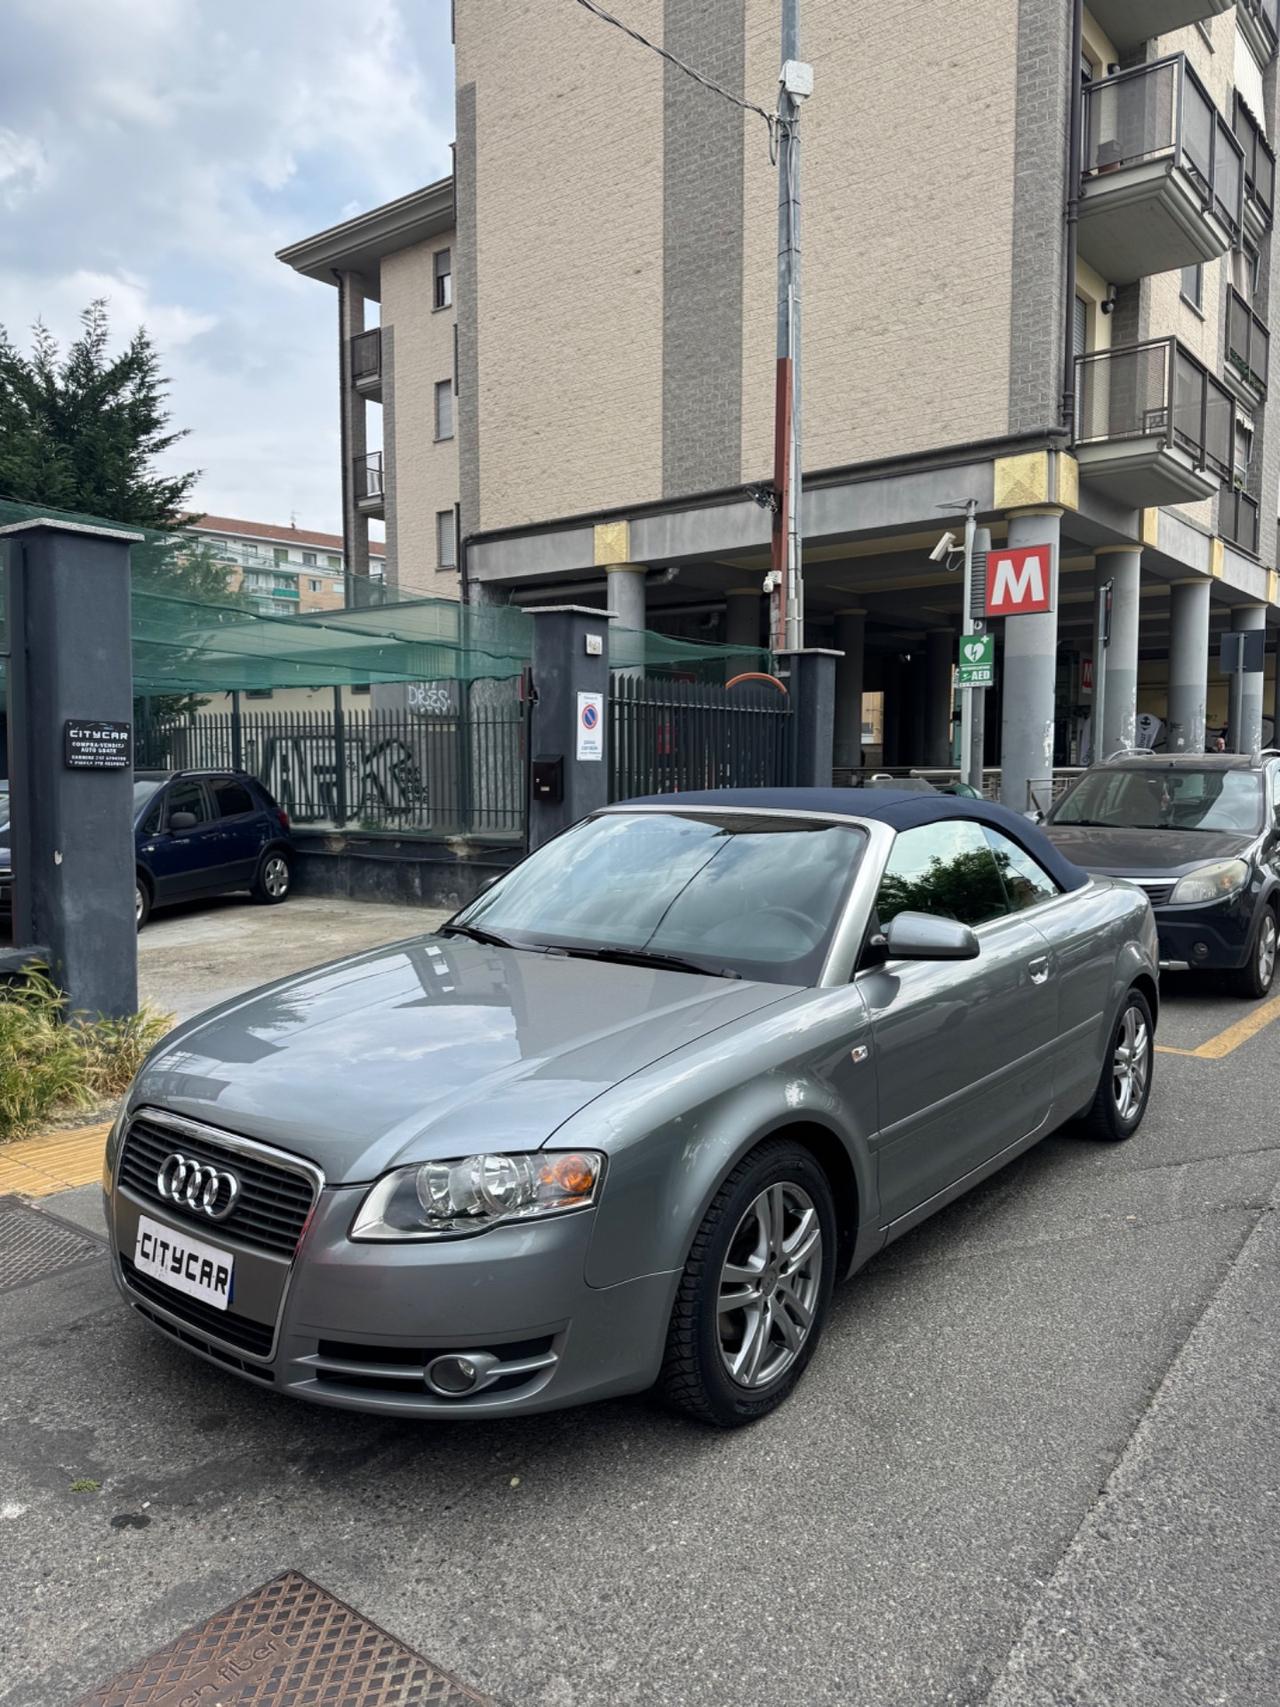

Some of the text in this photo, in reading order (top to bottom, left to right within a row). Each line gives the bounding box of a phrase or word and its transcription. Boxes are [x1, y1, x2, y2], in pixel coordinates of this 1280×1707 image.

[991, 556, 1045, 606] M
[971, 671, 990, 680] AED
[69, 730, 128, 740] CITYCAR
[141, 1232, 229, 1295] CITYCAR
[218, 1640, 278, 1682] fiber
